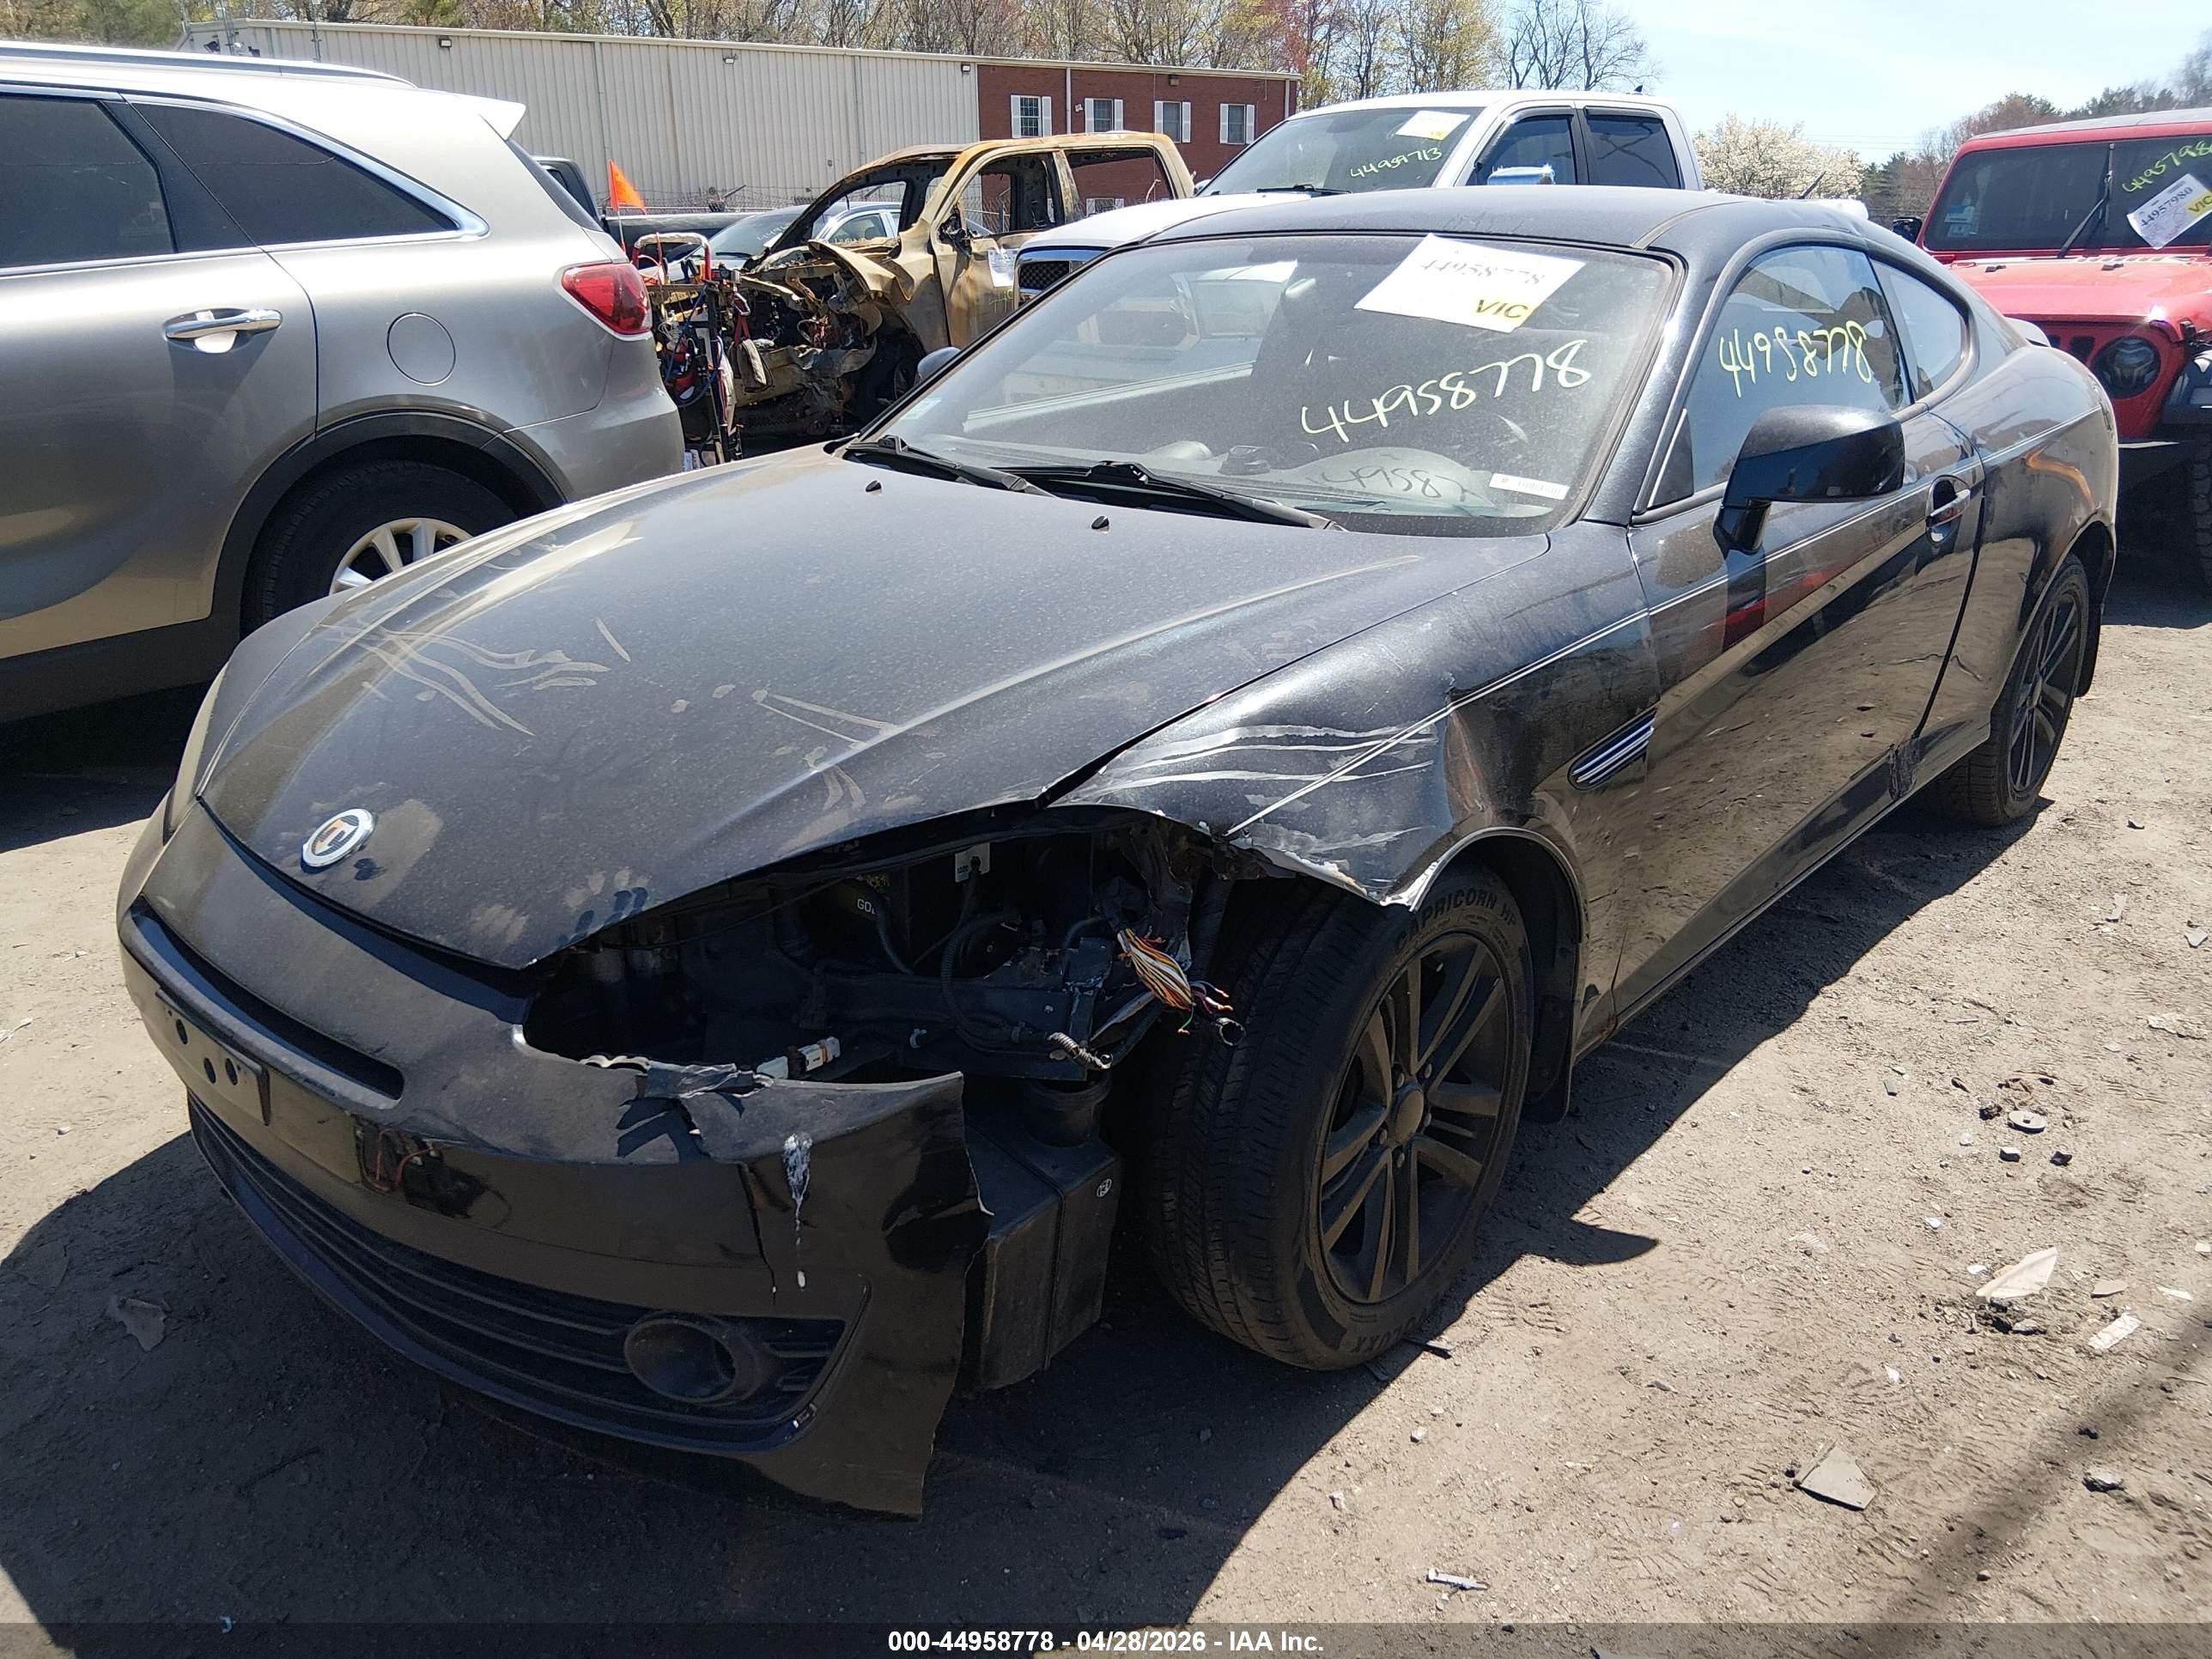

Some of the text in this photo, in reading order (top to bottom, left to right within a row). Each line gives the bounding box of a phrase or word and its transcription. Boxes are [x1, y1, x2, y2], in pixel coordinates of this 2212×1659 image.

[1349, 147, 1443, 179] 44959713
[2121, 139, 2212, 193] 4495798
[2141, 185, 2194, 228] 44957980
[2187, 196, 2212, 213] VIC
[1419, 258, 1546, 284] 449588
[1475, 298, 1530, 319] VIC
[1718, 319, 1873, 398] 44958778
[1300, 338, 1592, 444] 44958778
